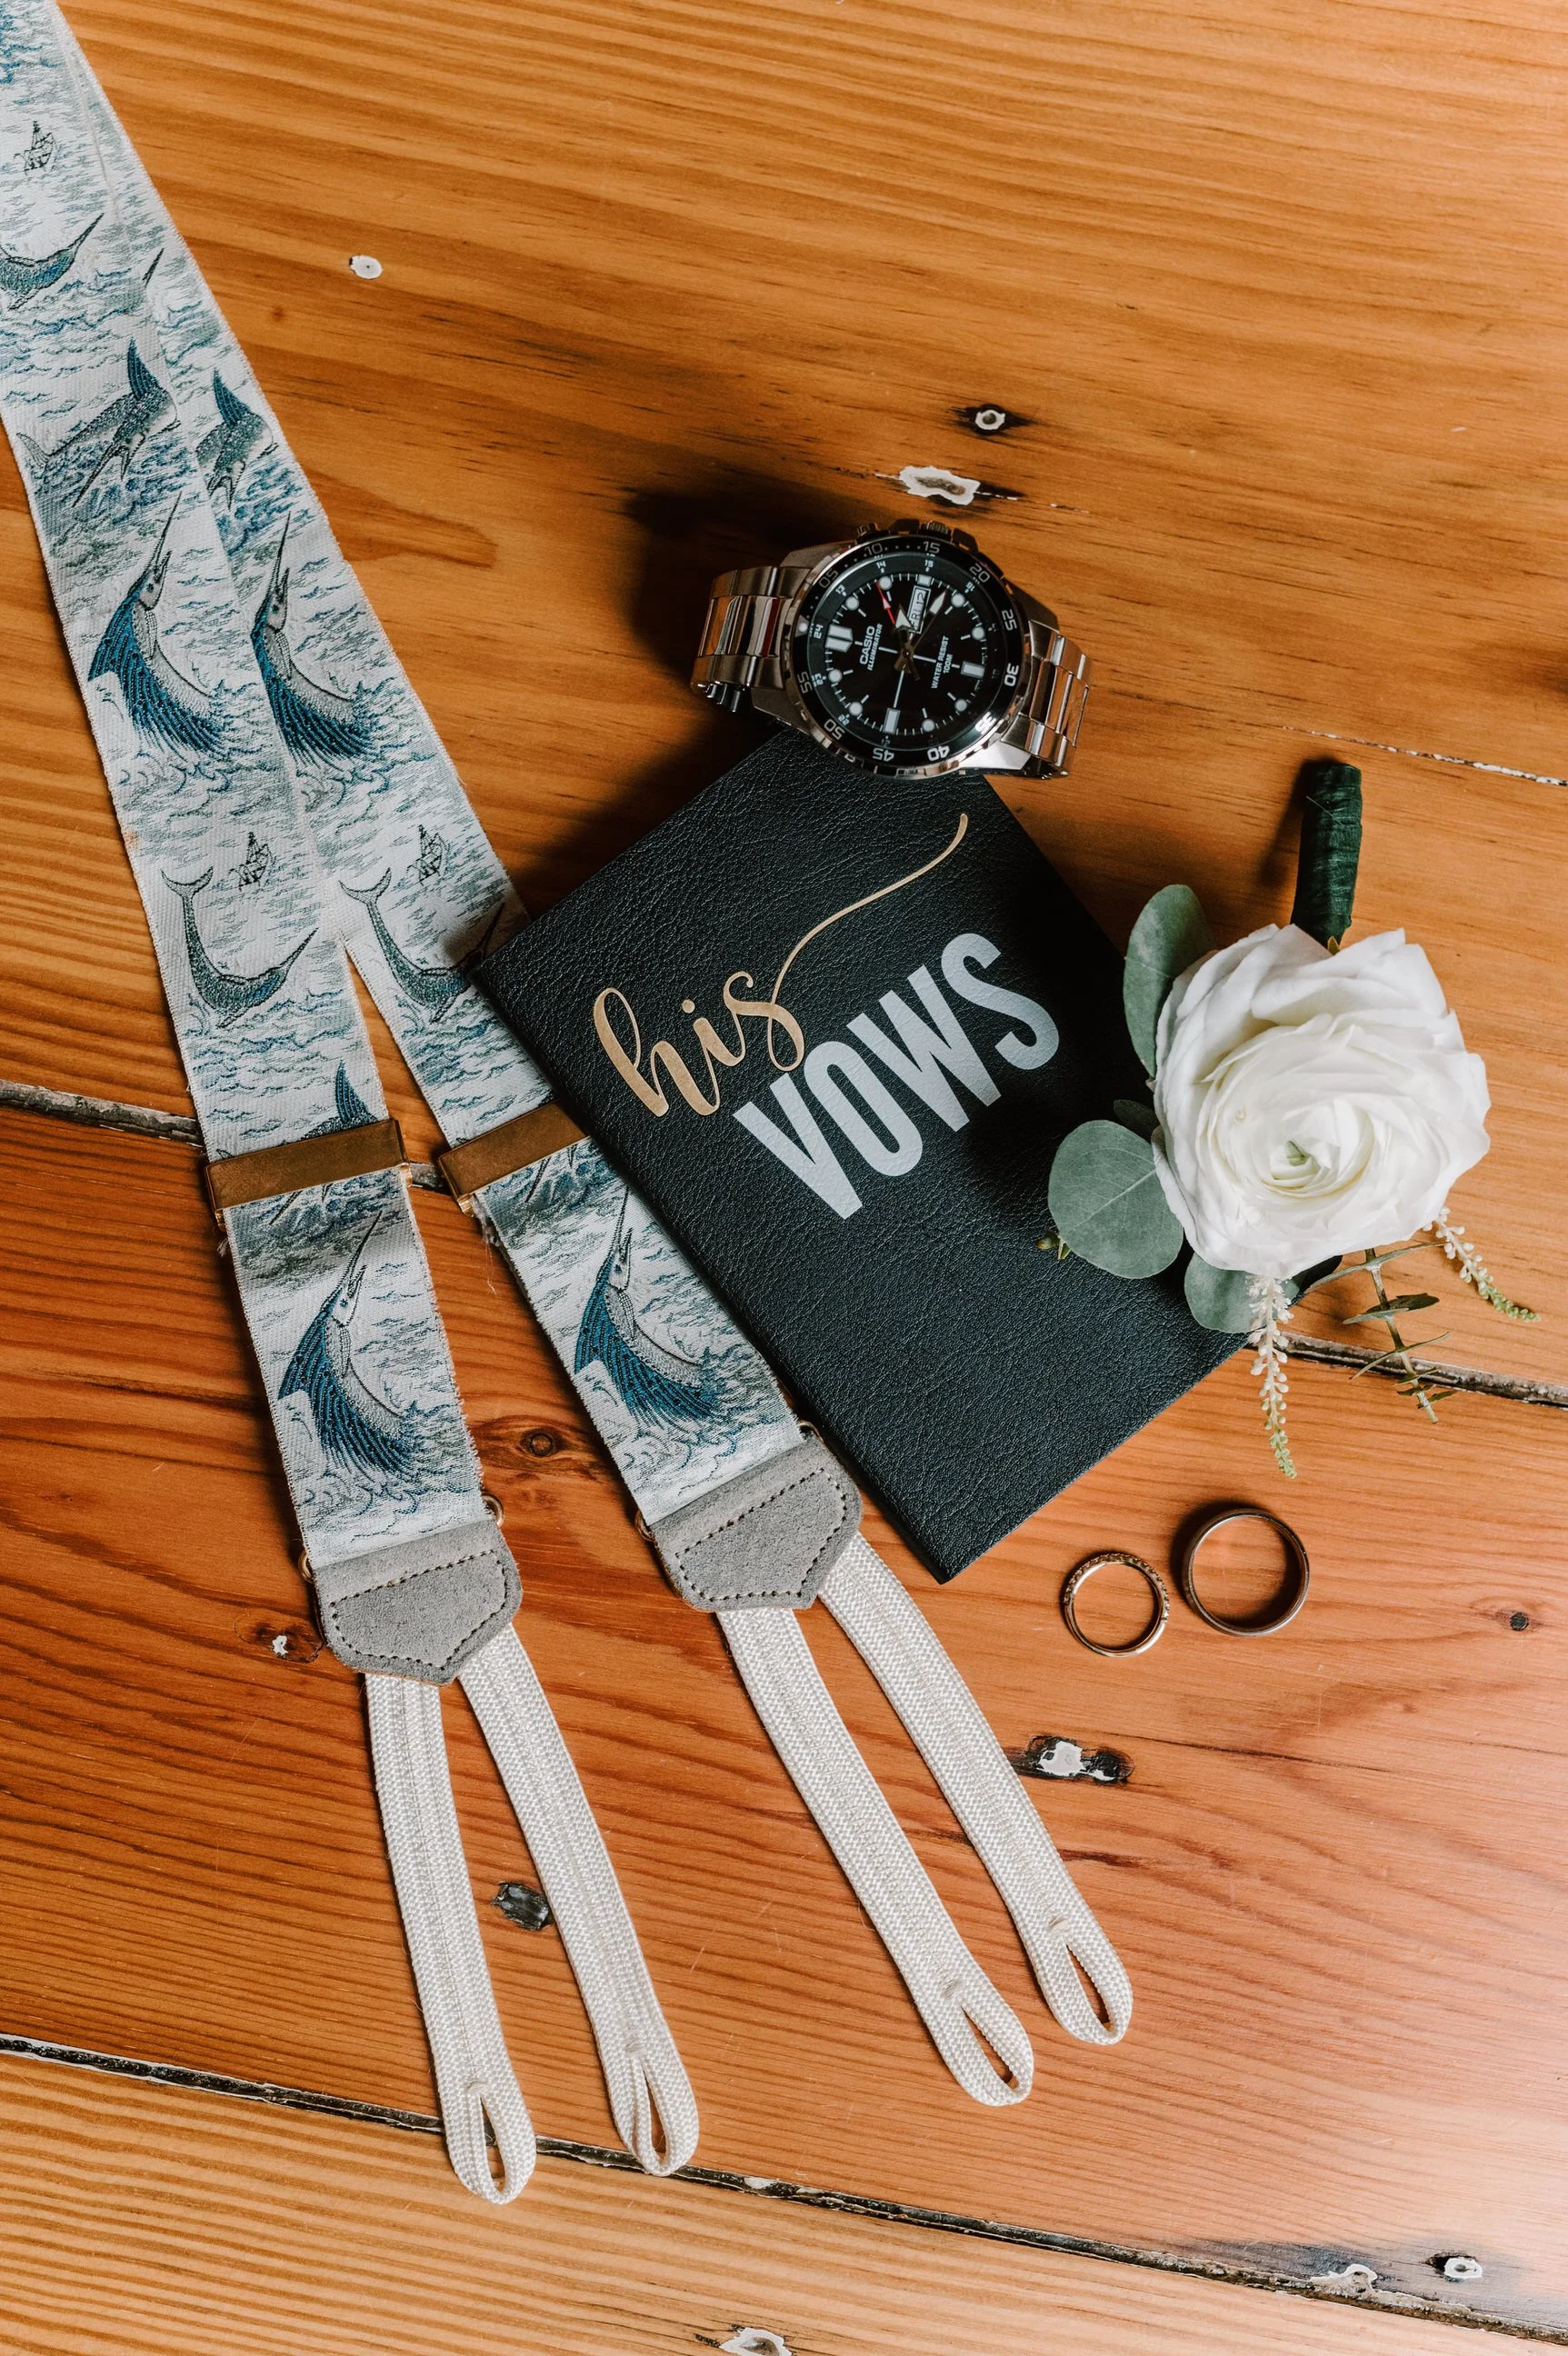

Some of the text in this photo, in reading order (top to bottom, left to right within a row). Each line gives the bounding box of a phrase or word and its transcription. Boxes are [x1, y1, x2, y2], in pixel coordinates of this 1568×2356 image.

[864, 543, 883, 555] 10
[924, 541, 940, 554] 15
[818, 570, 838, 589] 05
[969, 563, 990, 583] 20
[1001, 609, 1017, 631] 25
[814, 624, 824, 639] 24
[859, 625, 875, 665] CASIO
[866, 624, 883, 671] ILLUMINATOR
[930, 635, 949, 689] WATER RESIST
[943, 654, 954, 674] 100M
[797, 671, 813, 694] 55
[1004, 662, 1020, 687] 30
[824, 719, 845, 740] 50
[974, 711, 997, 735] 35
[872, 747, 894, 762] 45
[926, 745, 950, 762] 40
[594, 814, 968, 1116] his
[733, 933, 1060, 1219] VOWS
